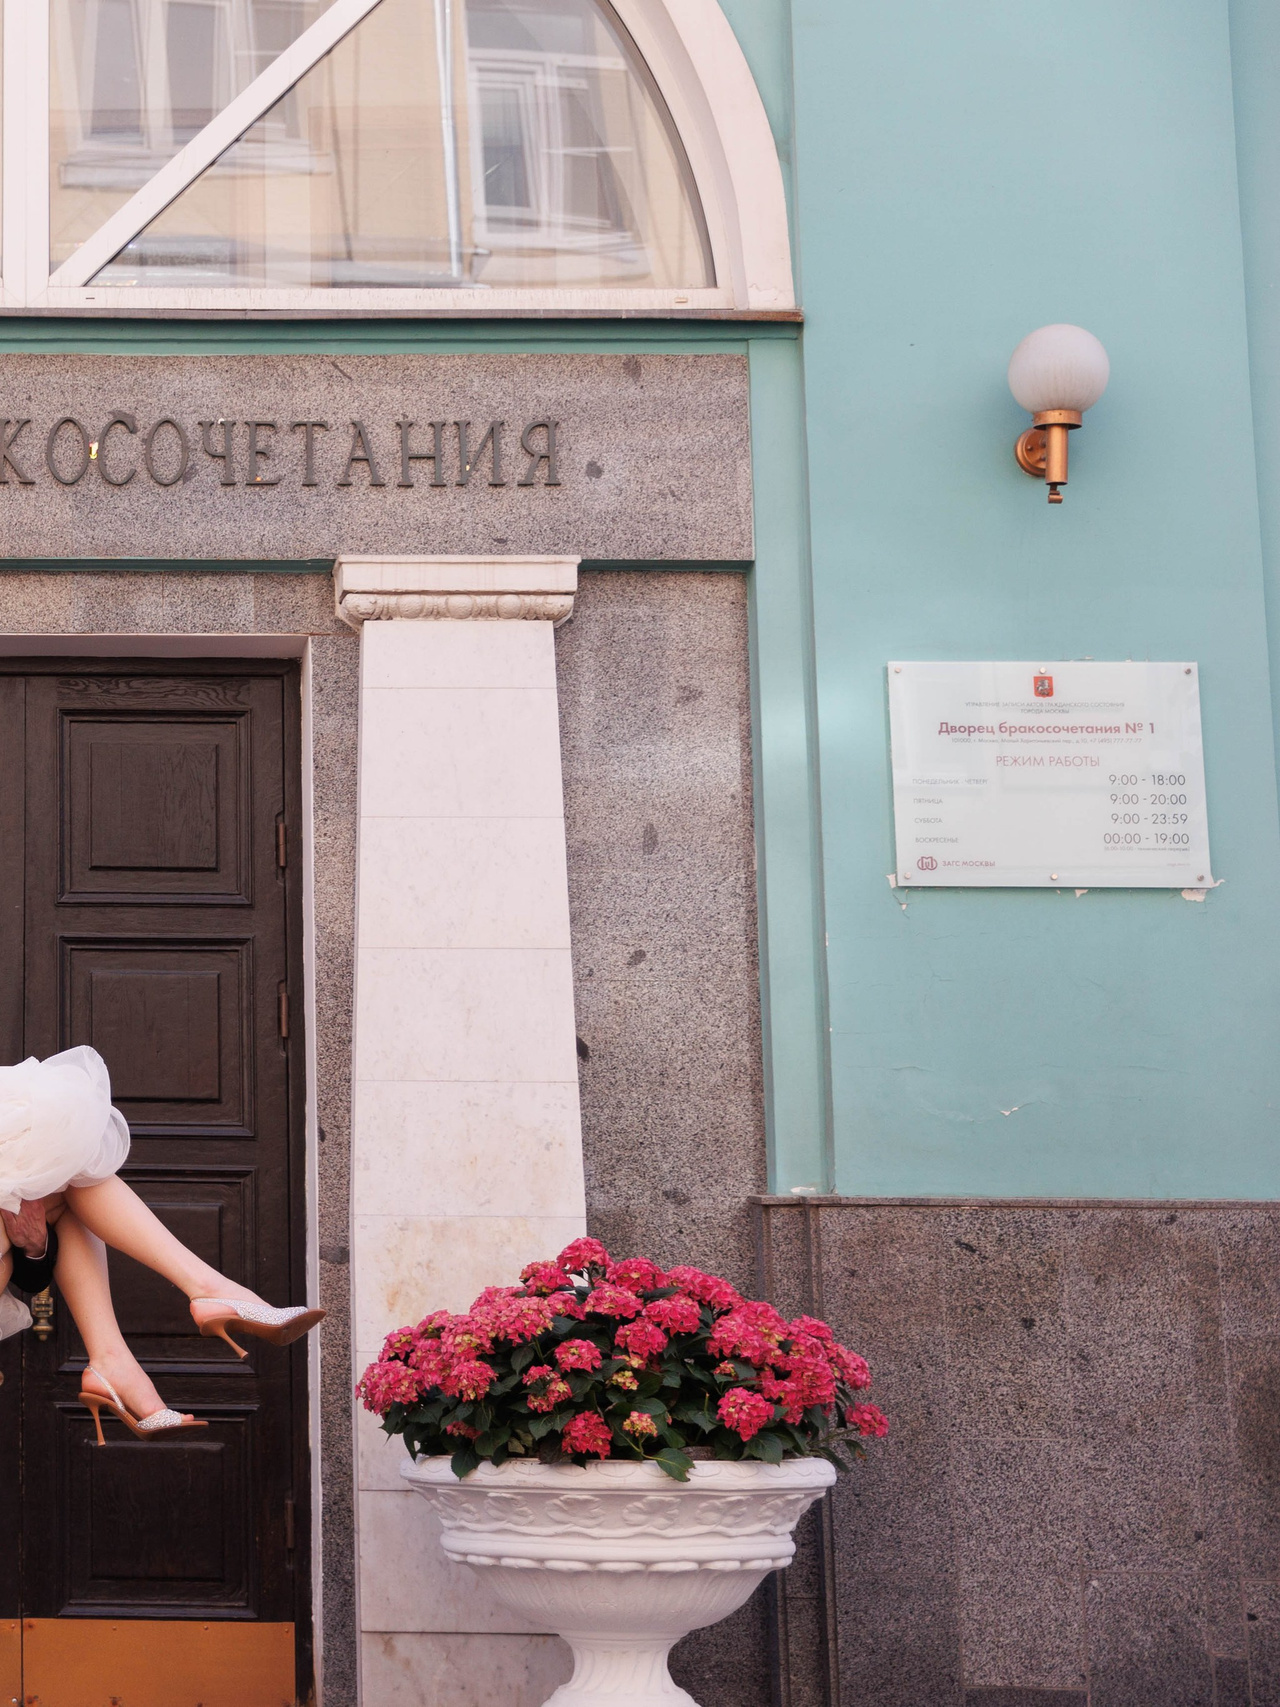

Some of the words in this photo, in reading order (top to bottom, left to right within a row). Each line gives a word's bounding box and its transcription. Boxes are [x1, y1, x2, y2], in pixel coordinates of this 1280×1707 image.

[938, 721, 995, 737] Дворец
[998, 721, 1121, 737] бракосочетания
[1149, 722, 1155, 734] 1
[996, 755, 1045, 767] РЕЖИМ
[1048, 755, 1100, 767] РАБОТЫ
[1108, 774, 1138, 785] 9:00
[1151, 774, 1186, 785] 18:00
[1110, 793, 1139, 805] 9:00
[1150, 793, 1187, 805] 20:00
[1111, 813, 1140, 824] 9:00
[1151, 813, 1188, 824] 23:59
[1103, 832, 1141, 844] 00:00
[1154, 832, 1190, 844] 19:00
